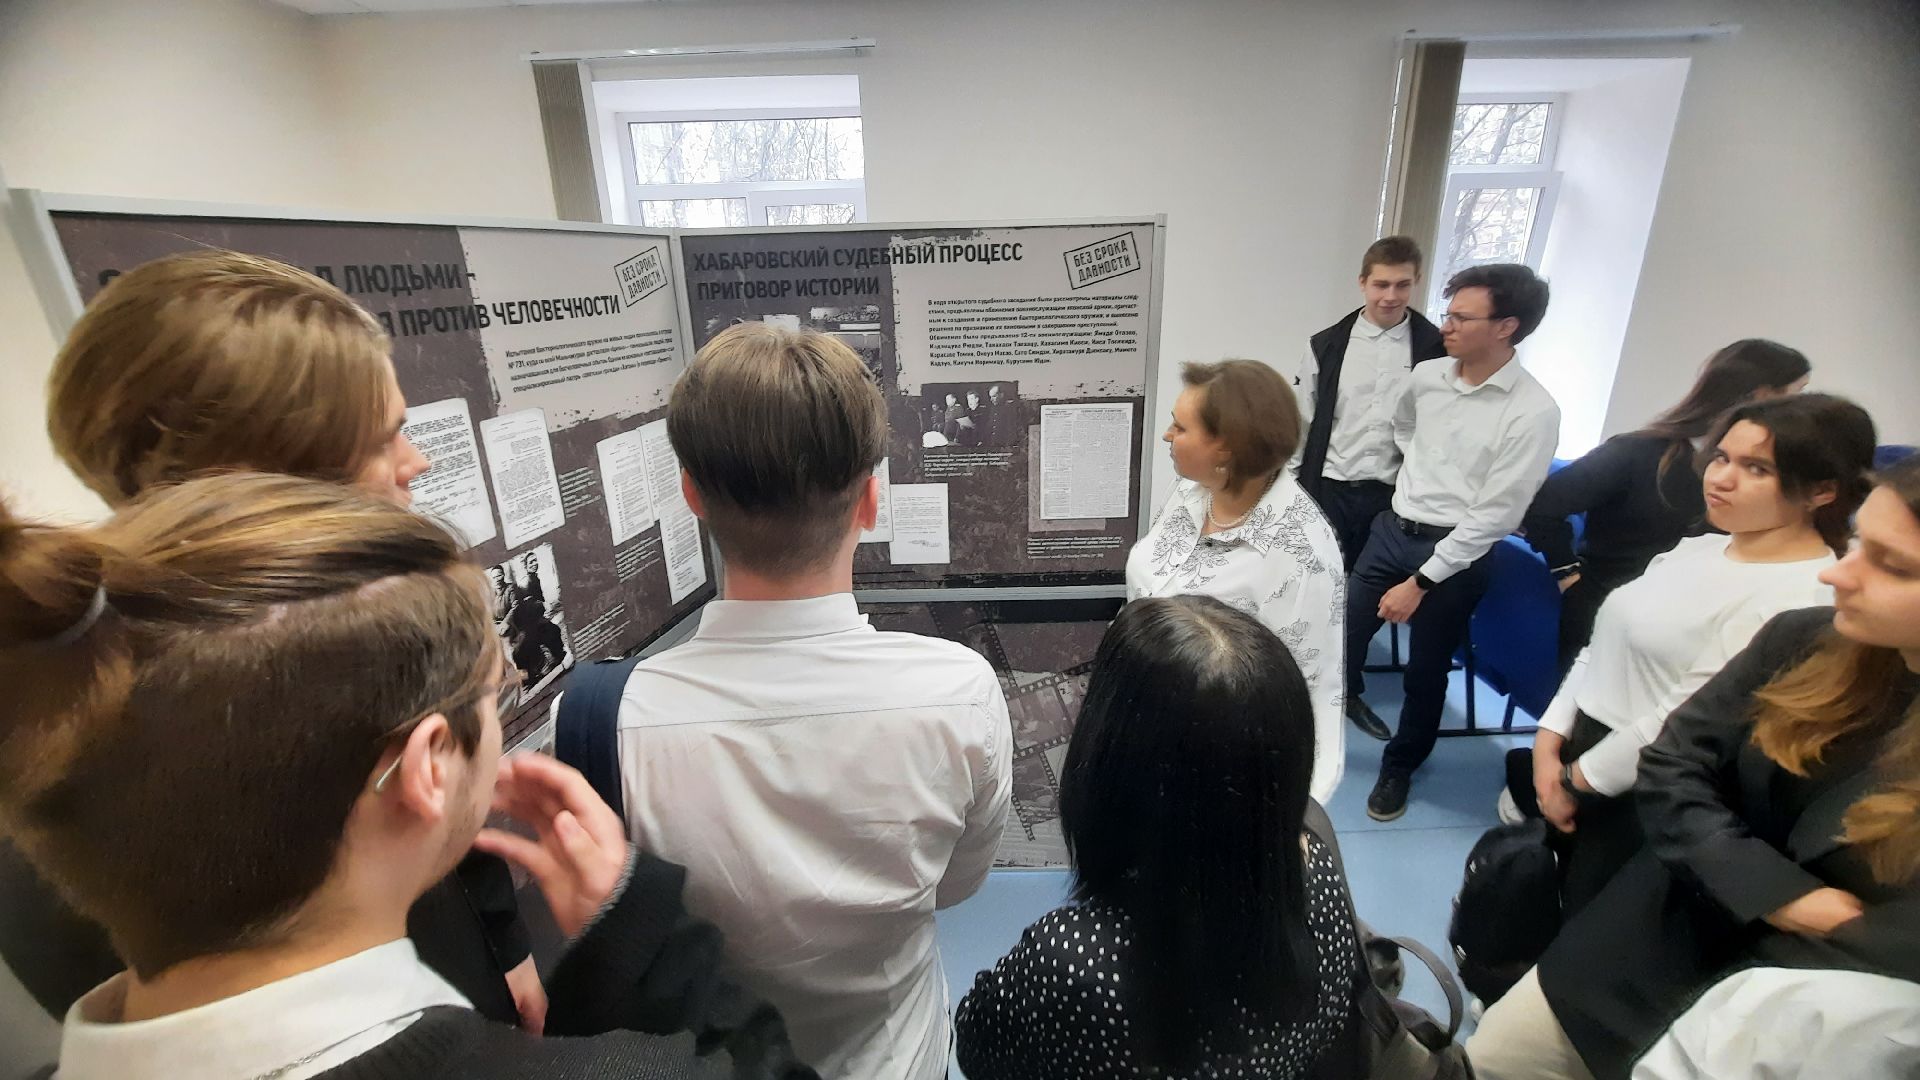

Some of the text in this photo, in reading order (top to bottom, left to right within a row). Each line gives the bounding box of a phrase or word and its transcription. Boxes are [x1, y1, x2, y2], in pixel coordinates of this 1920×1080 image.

[622, 254, 658, 282] БЕЗ СРОКА
[693, 242, 1023, 272] ХАБАРОВСКИЙ СУДЕБНЫЙ ПРОЦЕСС
[1073, 240, 1128, 267] БЕЗ СРОКА
[1078, 254, 1131, 282] ДАВНОСТИ
[344, 263, 463, 297] ЛЮДЬМИ
[628, 269, 662, 299] ДАВНОСТИ
[697, 276, 880, 300] ПРИГОВОР ИСТОРИИ
[399, 303, 491, 337] ПРОТИВ
[493, 294, 621, 326] ЧЕЛОВЕЧНОСТИ
